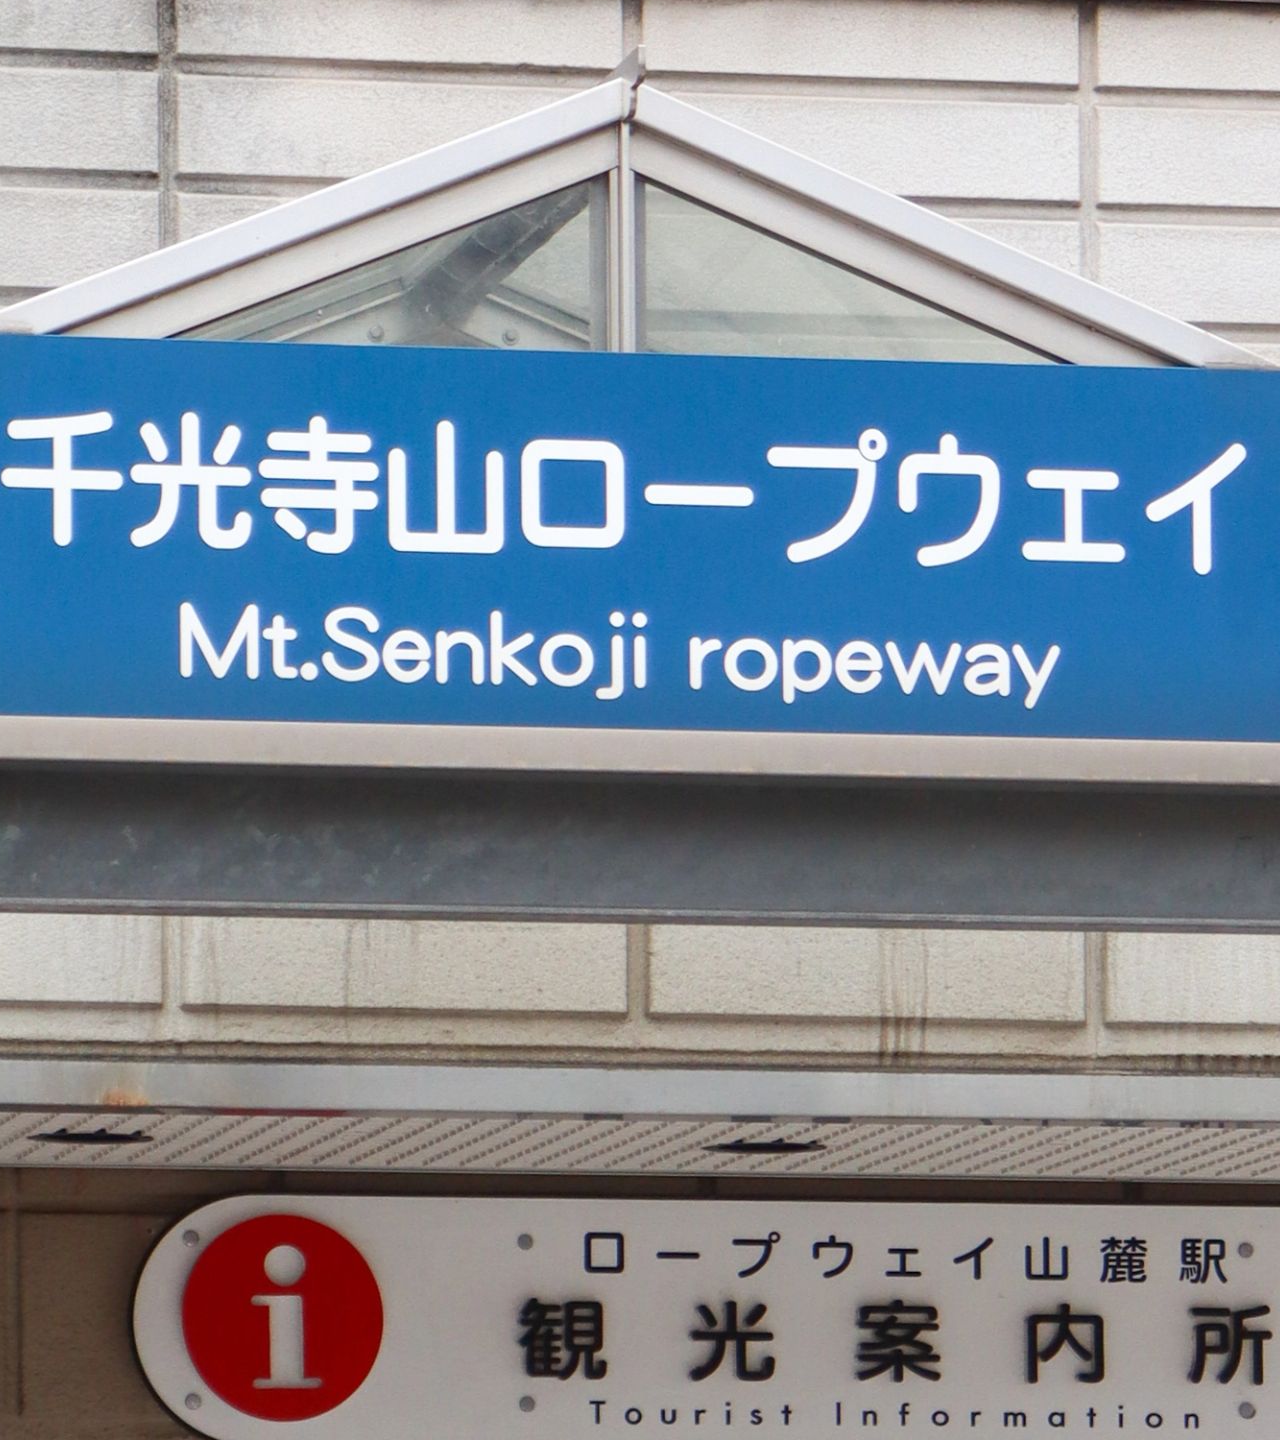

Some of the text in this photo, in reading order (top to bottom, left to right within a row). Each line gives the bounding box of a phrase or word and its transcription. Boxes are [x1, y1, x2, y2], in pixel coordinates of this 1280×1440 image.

[1, 410, 1248, 576] 千光寺山ロープウェイ
[177, 601, 1062, 709] Mt.Senkoji ropeway
[583, 1232, 1229, 1284] ロープウェイ山麓駅
[517, 1295, 1274, 1386] 観光案内所
[589, 1398, 1204, 1433] Tourist Information
